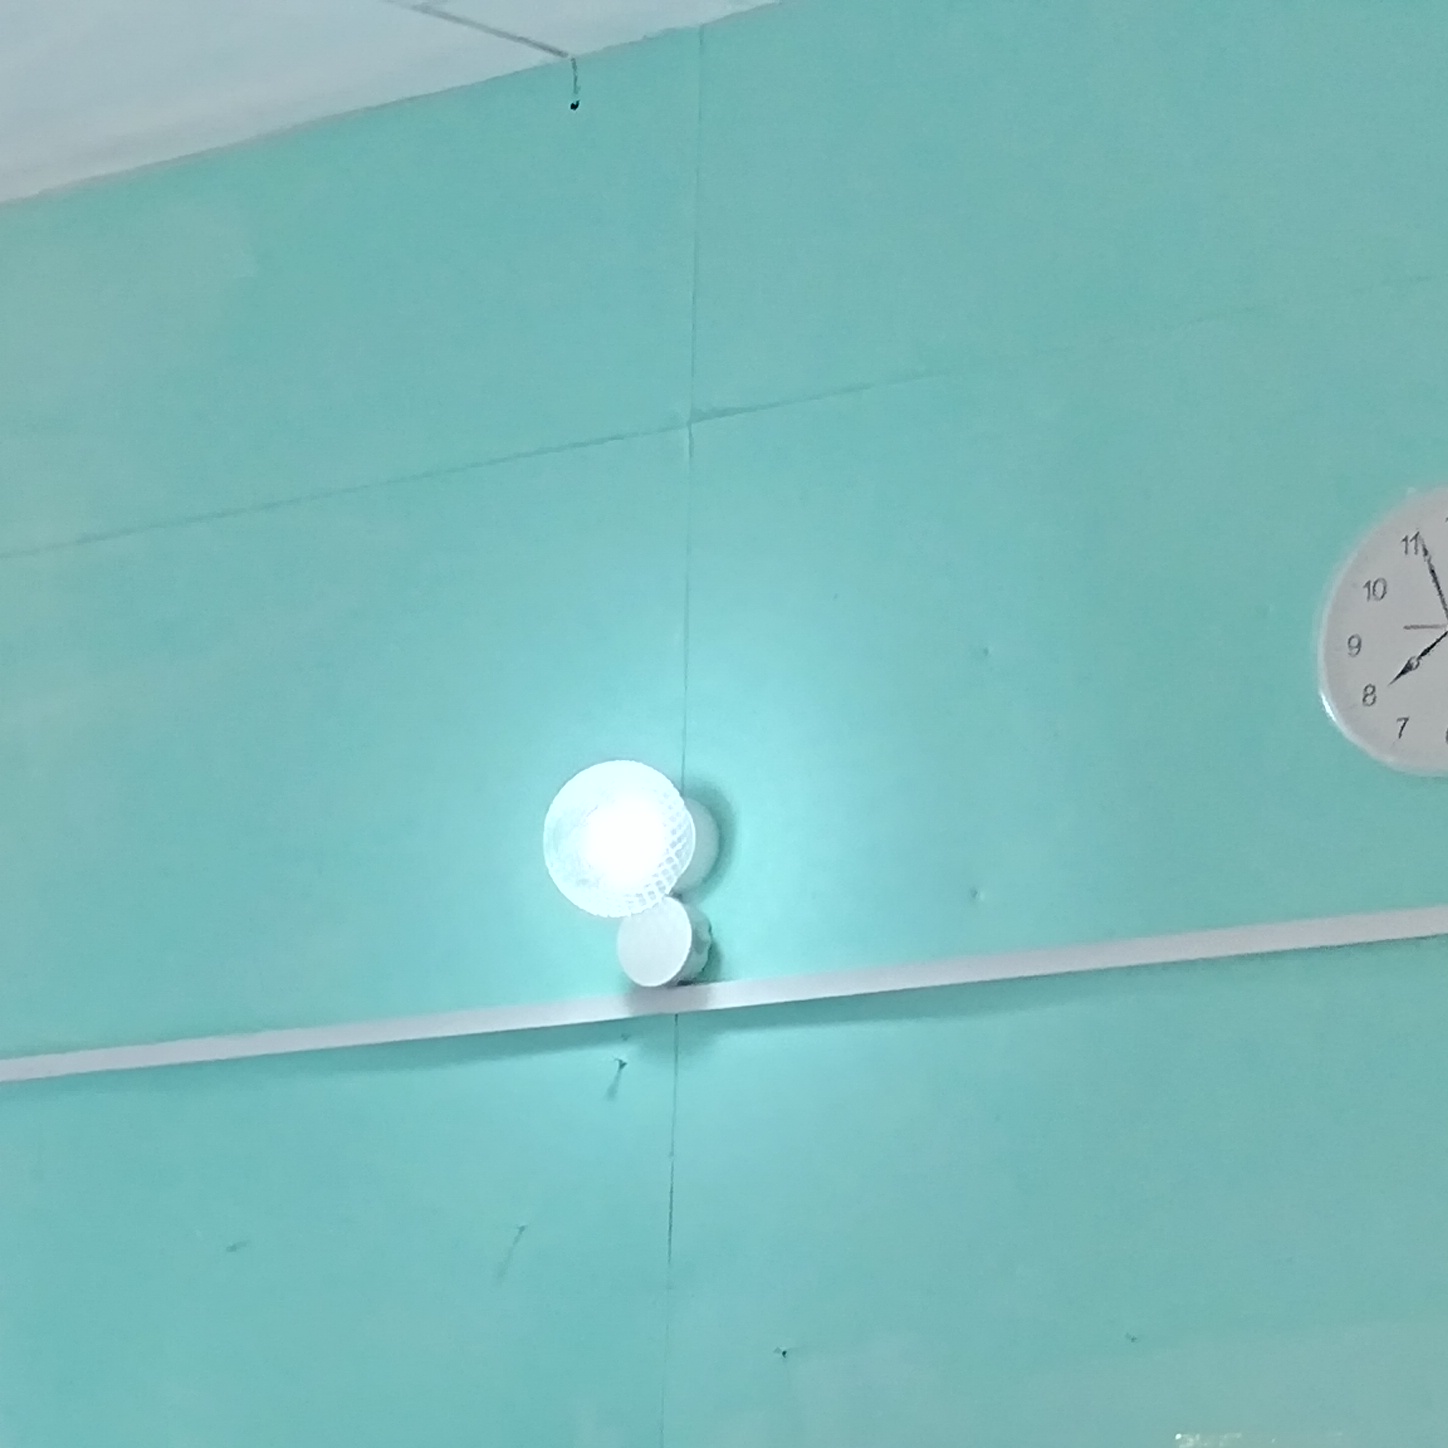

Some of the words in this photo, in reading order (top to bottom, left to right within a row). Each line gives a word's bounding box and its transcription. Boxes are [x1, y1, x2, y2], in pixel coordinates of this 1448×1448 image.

[1400, 531, 1421, 556] 11
[1362, 577, 1387, 602] 10
[1347, 634, 1363, 658] 9
[1362, 683, 1377, 708] 8
[1396, 716, 1411, 740] 7
